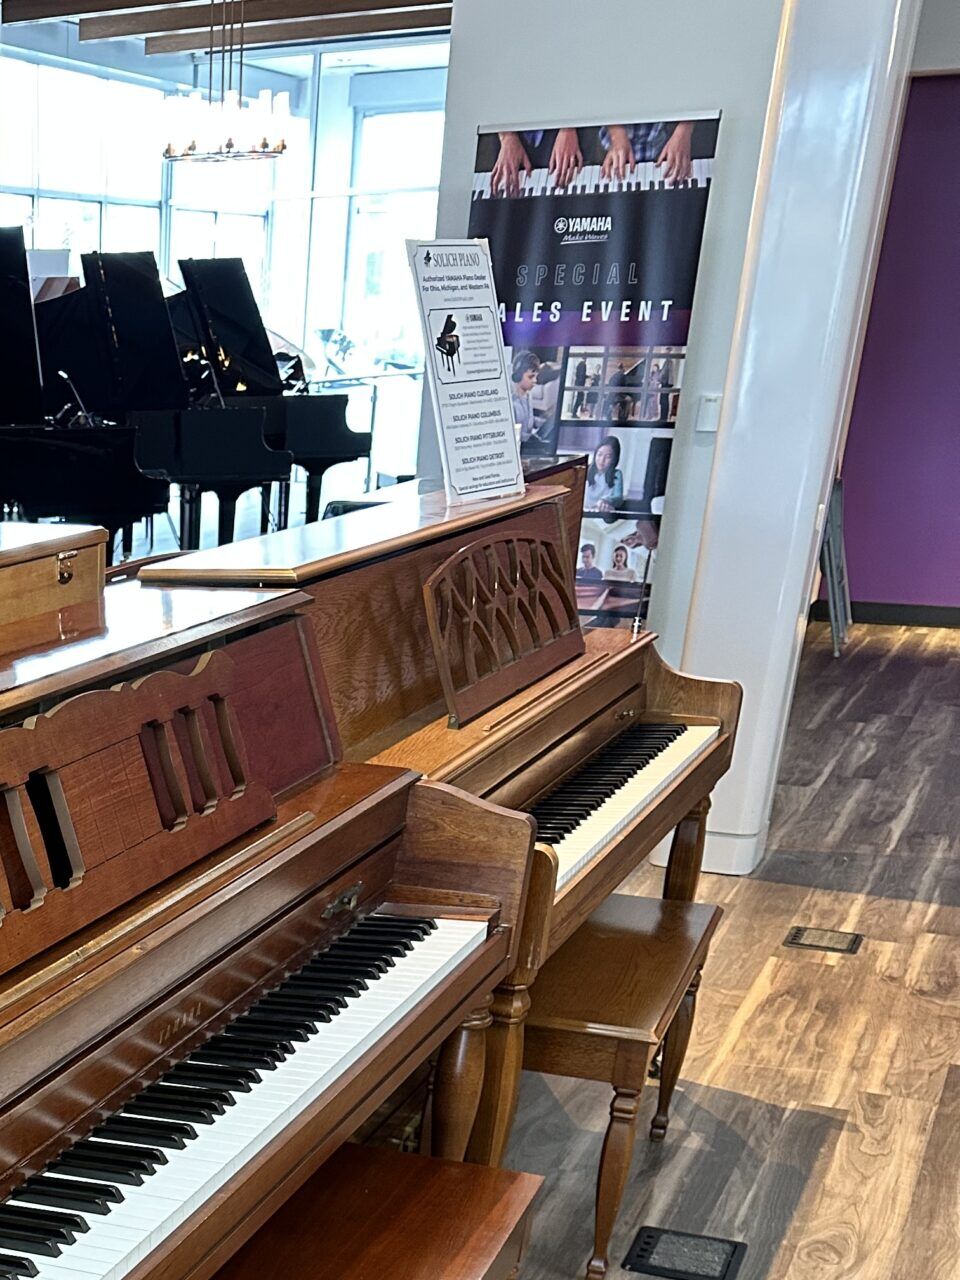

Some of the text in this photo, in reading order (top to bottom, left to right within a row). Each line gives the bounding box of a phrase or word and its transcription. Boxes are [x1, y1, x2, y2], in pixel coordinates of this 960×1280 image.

[569, 216, 612, 232] YAMAHA
[562, 233, 608, 241] Make Waves
[433, 252, 480, 267] SOLICH PIANO
[516, 263, 639, 287] SPECIAL
[497, 299, 673, 323] ALES EVENT
[448, 392, 464, 400] SOLICH
[477, 388, 499, 397] CLEVELAND
[452, 410, 502, 422] SOLICH PIANO COLUMBUS
[455, 435, 470, 444] SOLICH
[470, 433, 482, 441] PIANO
[461, 452, 505, 465] SOLICH PIANO DETROIT
